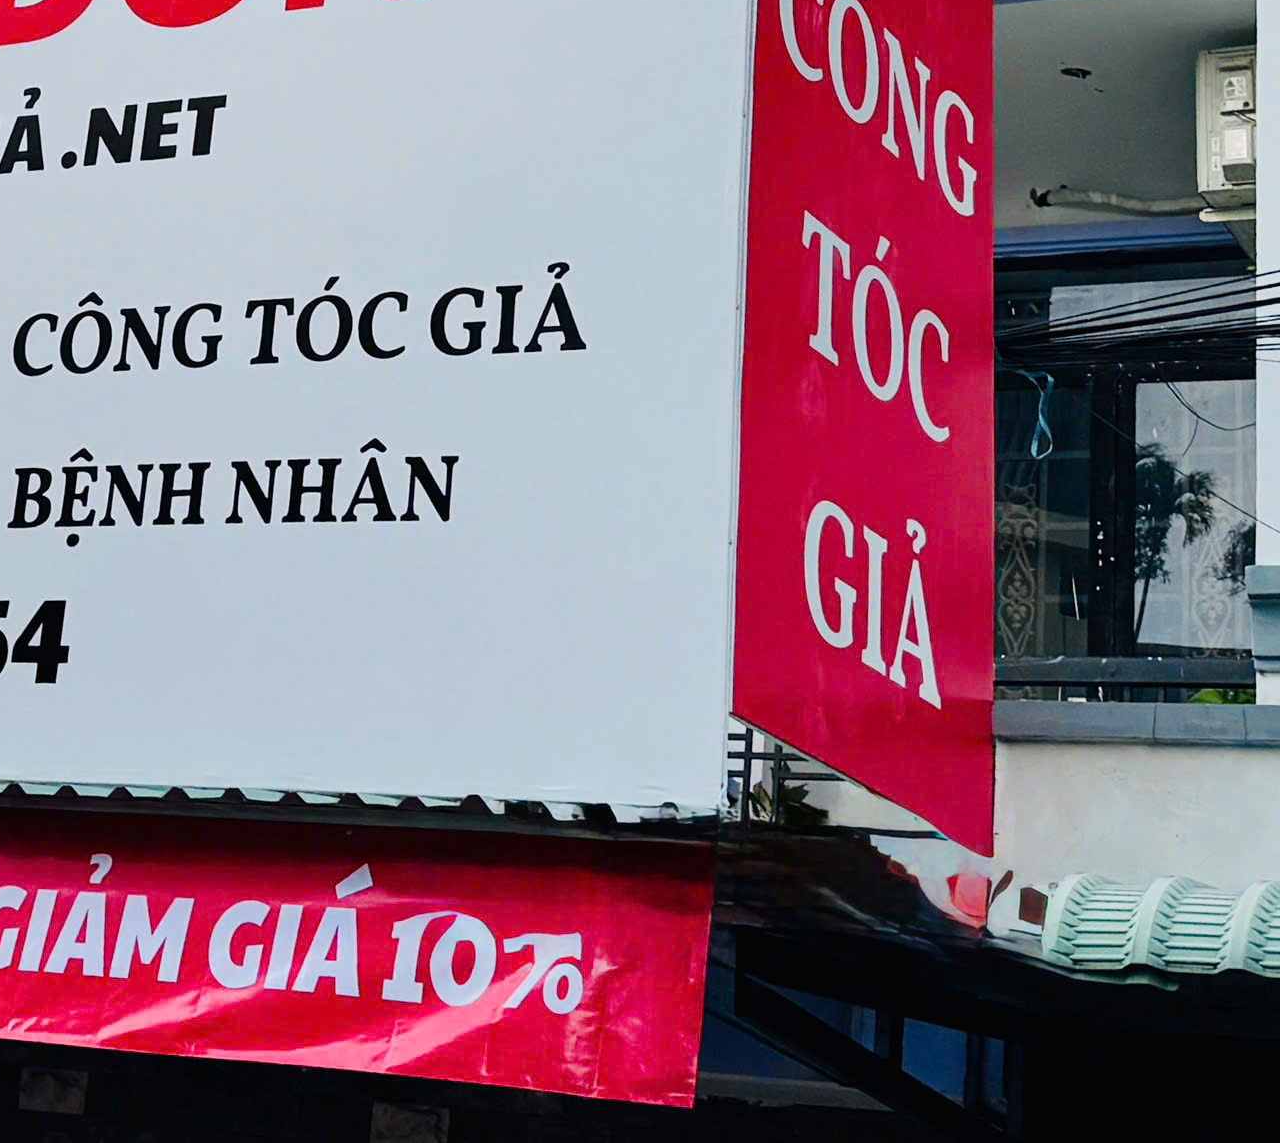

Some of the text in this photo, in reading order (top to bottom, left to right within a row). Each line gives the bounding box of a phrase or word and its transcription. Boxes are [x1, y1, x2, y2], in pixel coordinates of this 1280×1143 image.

[12, 291, 222, 377] CÔNG
[245, 276, 408, 365] TÓC
[429, 261, 587, 356] GIẢ
[802, 210, 950, 443] TÓC
[7, 447, 211, 547] BỆNH
[224, 437, 459, 524] NHÂN
[803, 500, 942, 710] GIẢ
[208, 863, 374, 999] GIÁ
[381, 910, 584, 1016] 10%
